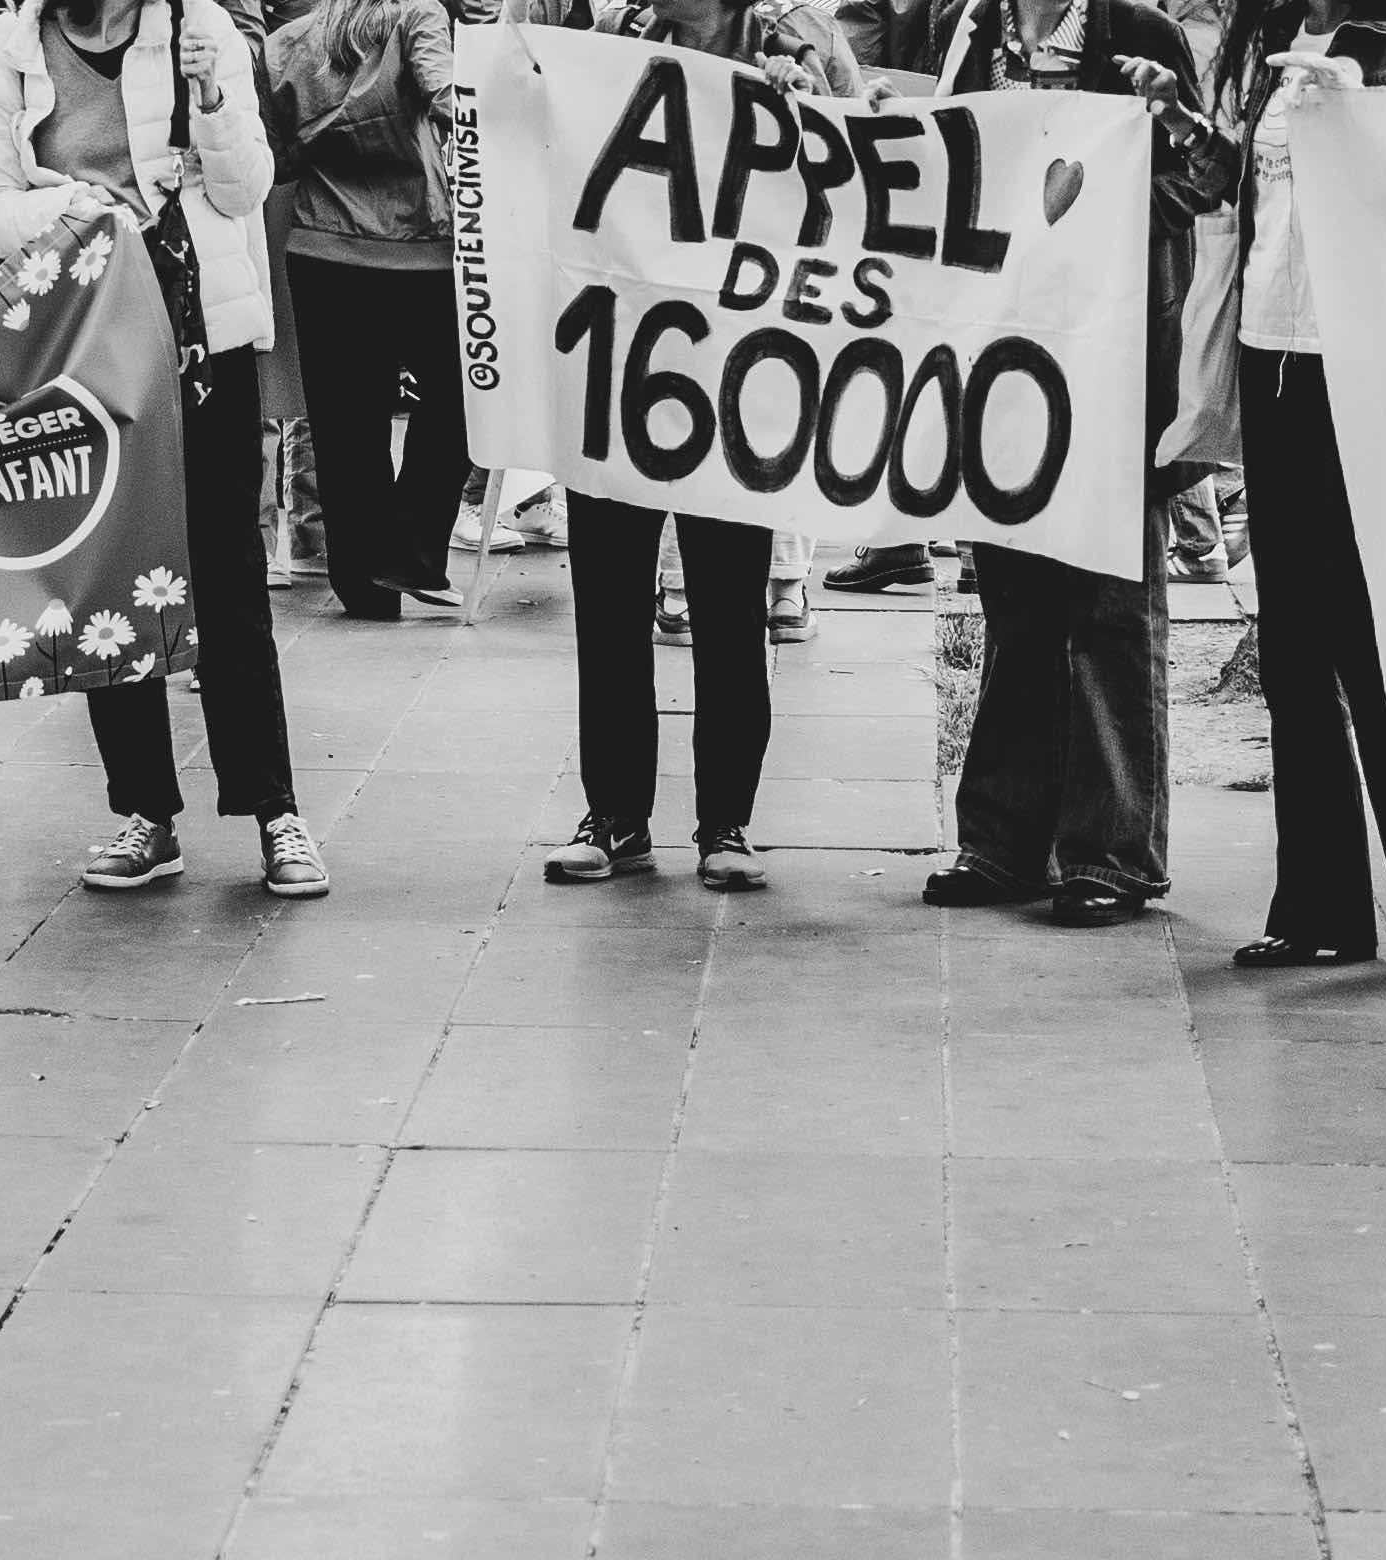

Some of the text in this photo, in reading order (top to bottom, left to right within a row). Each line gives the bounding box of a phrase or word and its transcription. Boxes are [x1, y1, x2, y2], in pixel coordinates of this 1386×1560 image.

[573, 55, 1011, 273] APPEL
[718, 241, 894, 329] DES
[554, 284, 1072, 525] 160000
